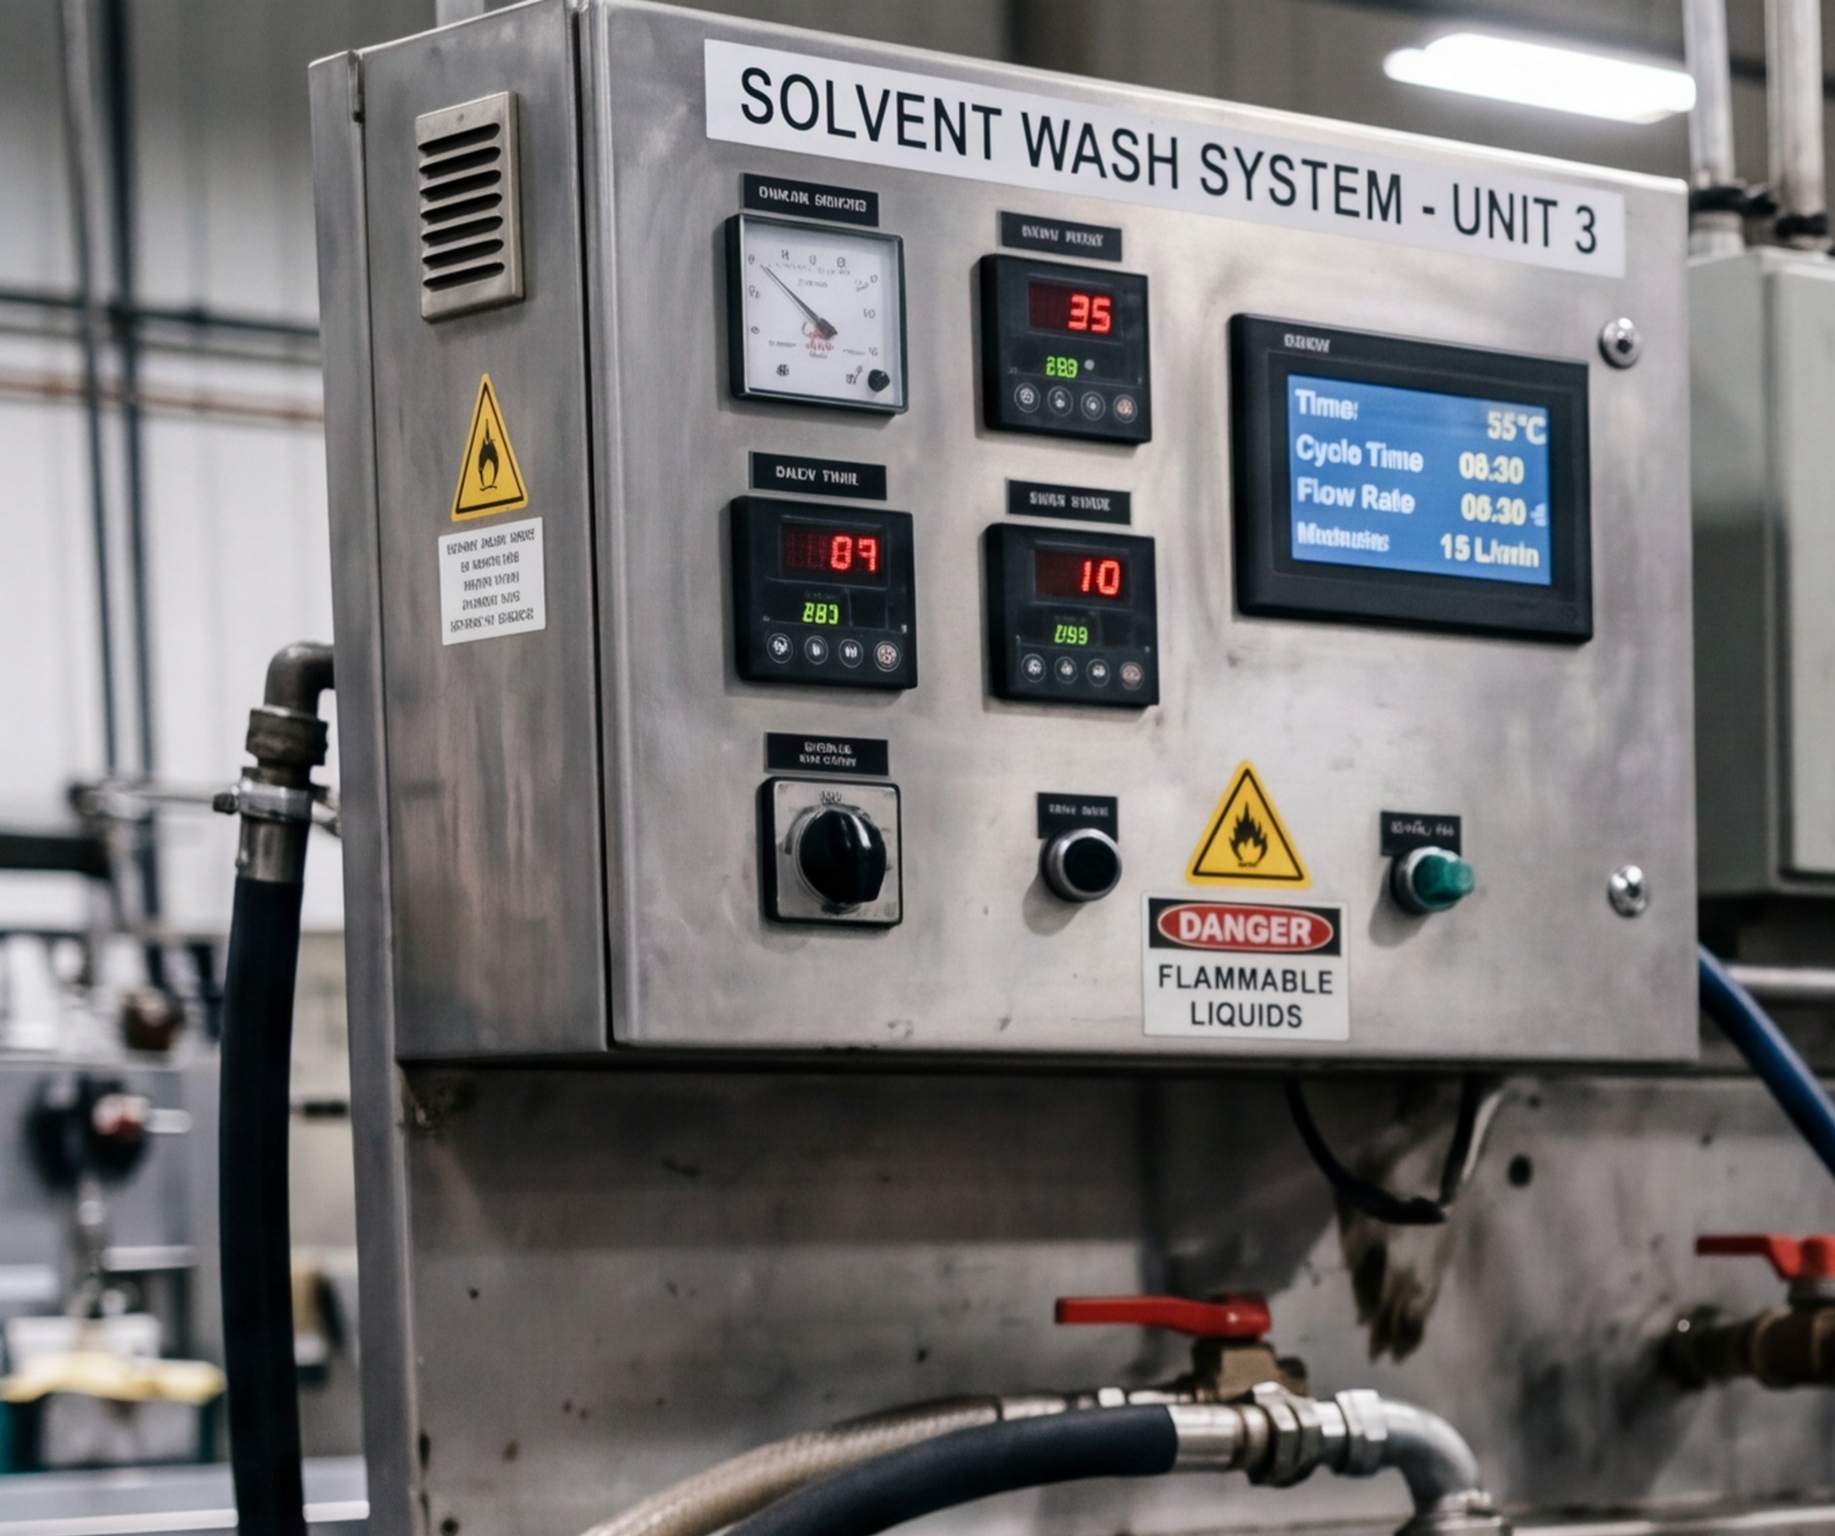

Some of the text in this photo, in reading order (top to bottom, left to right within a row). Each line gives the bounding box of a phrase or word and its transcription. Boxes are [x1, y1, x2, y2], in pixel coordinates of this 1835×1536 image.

[741, 67, 1596, 254] SOLVENT WASH SYSTEM - UNIT 3
[1068, 293, 1112, 334] 35
[1366, 441, 1424, 473] Time
[1297, 476, 1356, 508] Flow
[1440, 532, 1471, 562] 15
[1080, 558, 1121, 597] 10
[1180, 911, 1311, 944] DANGER
[1159, 964, 1333, 995] FLAMMABLE
[1191, 1001, 1303, 1029] LIQUIDS
